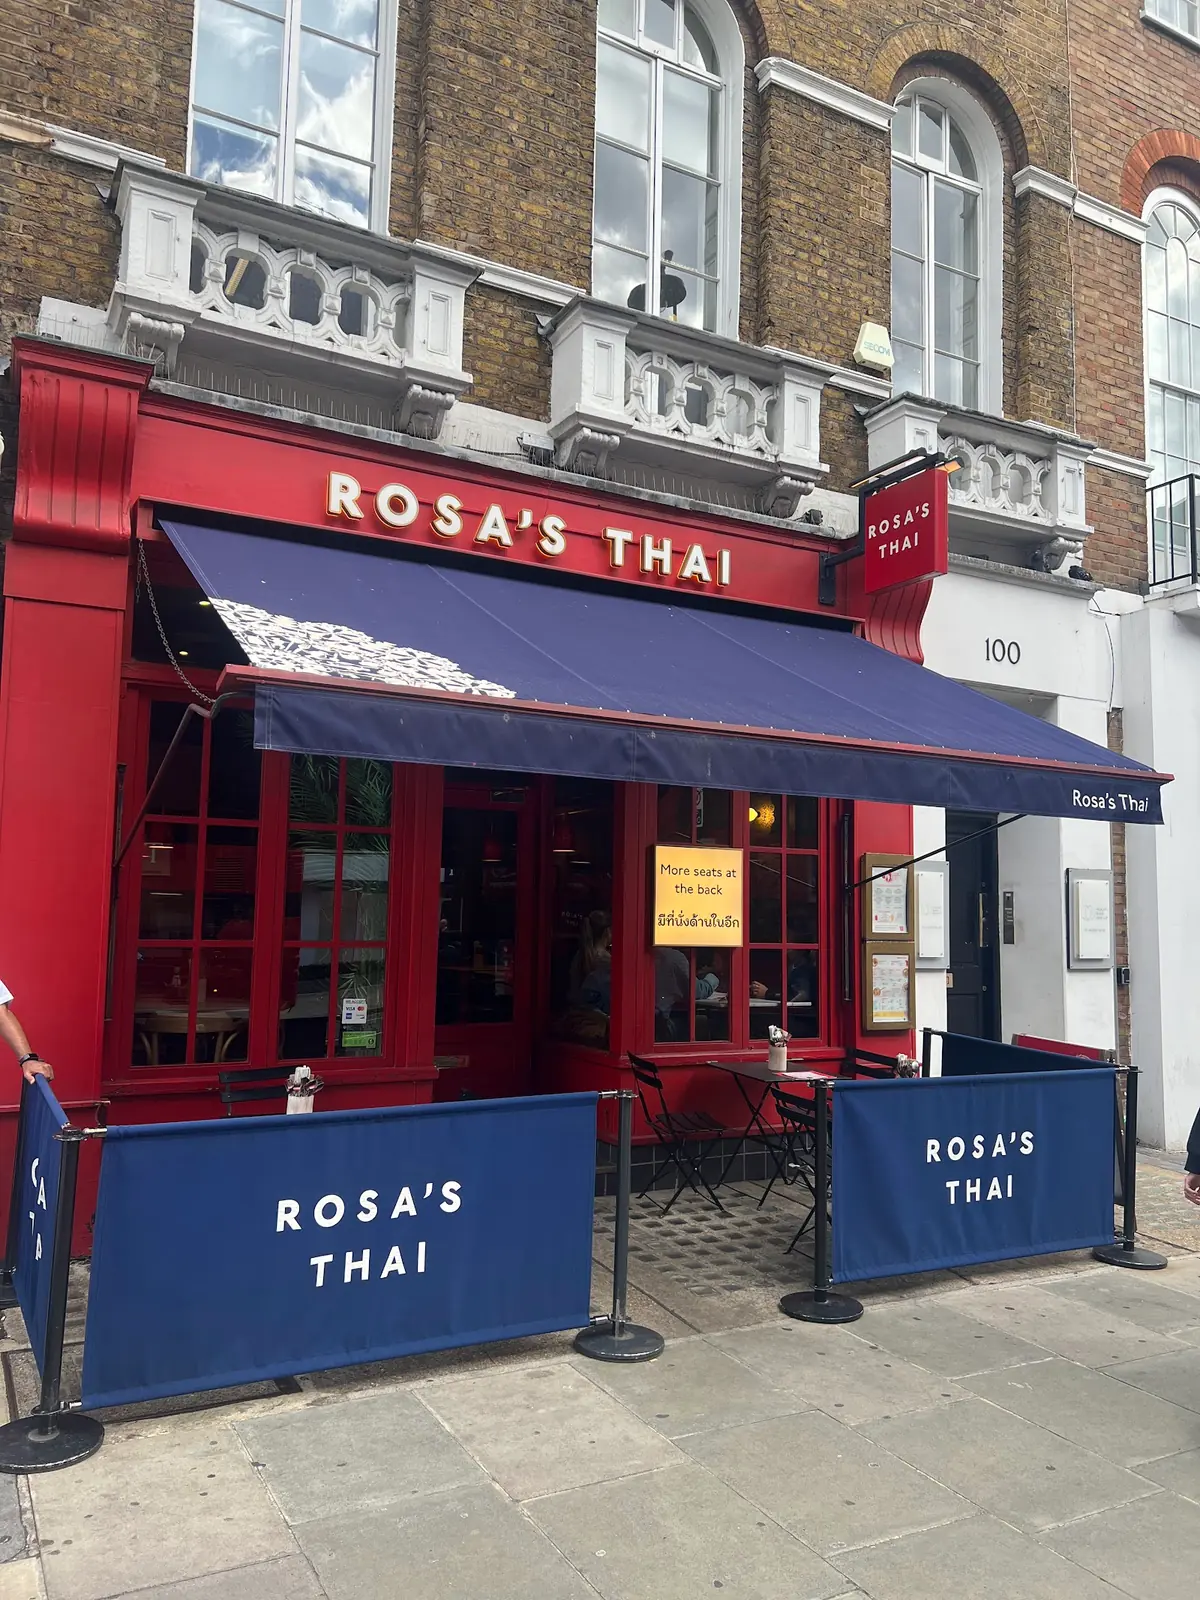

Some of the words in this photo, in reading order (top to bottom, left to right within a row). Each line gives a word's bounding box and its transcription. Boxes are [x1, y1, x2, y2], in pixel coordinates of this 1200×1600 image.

[326, 471, 567, 557] ROSA'S
[602, 526, 731, 587] THAI
[868, 502, 930, 540] ROSA'S
[878, 531, 919, 559] THAI
[985, 637, 1021, 665] 100
[1072, 789, 1117, 810] Rosa's
[1117, 793, 1149, 812] Thai
[660, 863, 690, 877] More
[693, 866, 723, 878] seats
[725, 867, 737, 878] at
[674, 883, 694, 895] the
[697, 884, 723, 896] back
[926, 1130, 1034, 1163] ROSA'S
[945, 1174, 1013, 1205] THAI
[275, 1179, 463, 1233] ROSA'S
[309, 1240, 427, 1287] THAI
